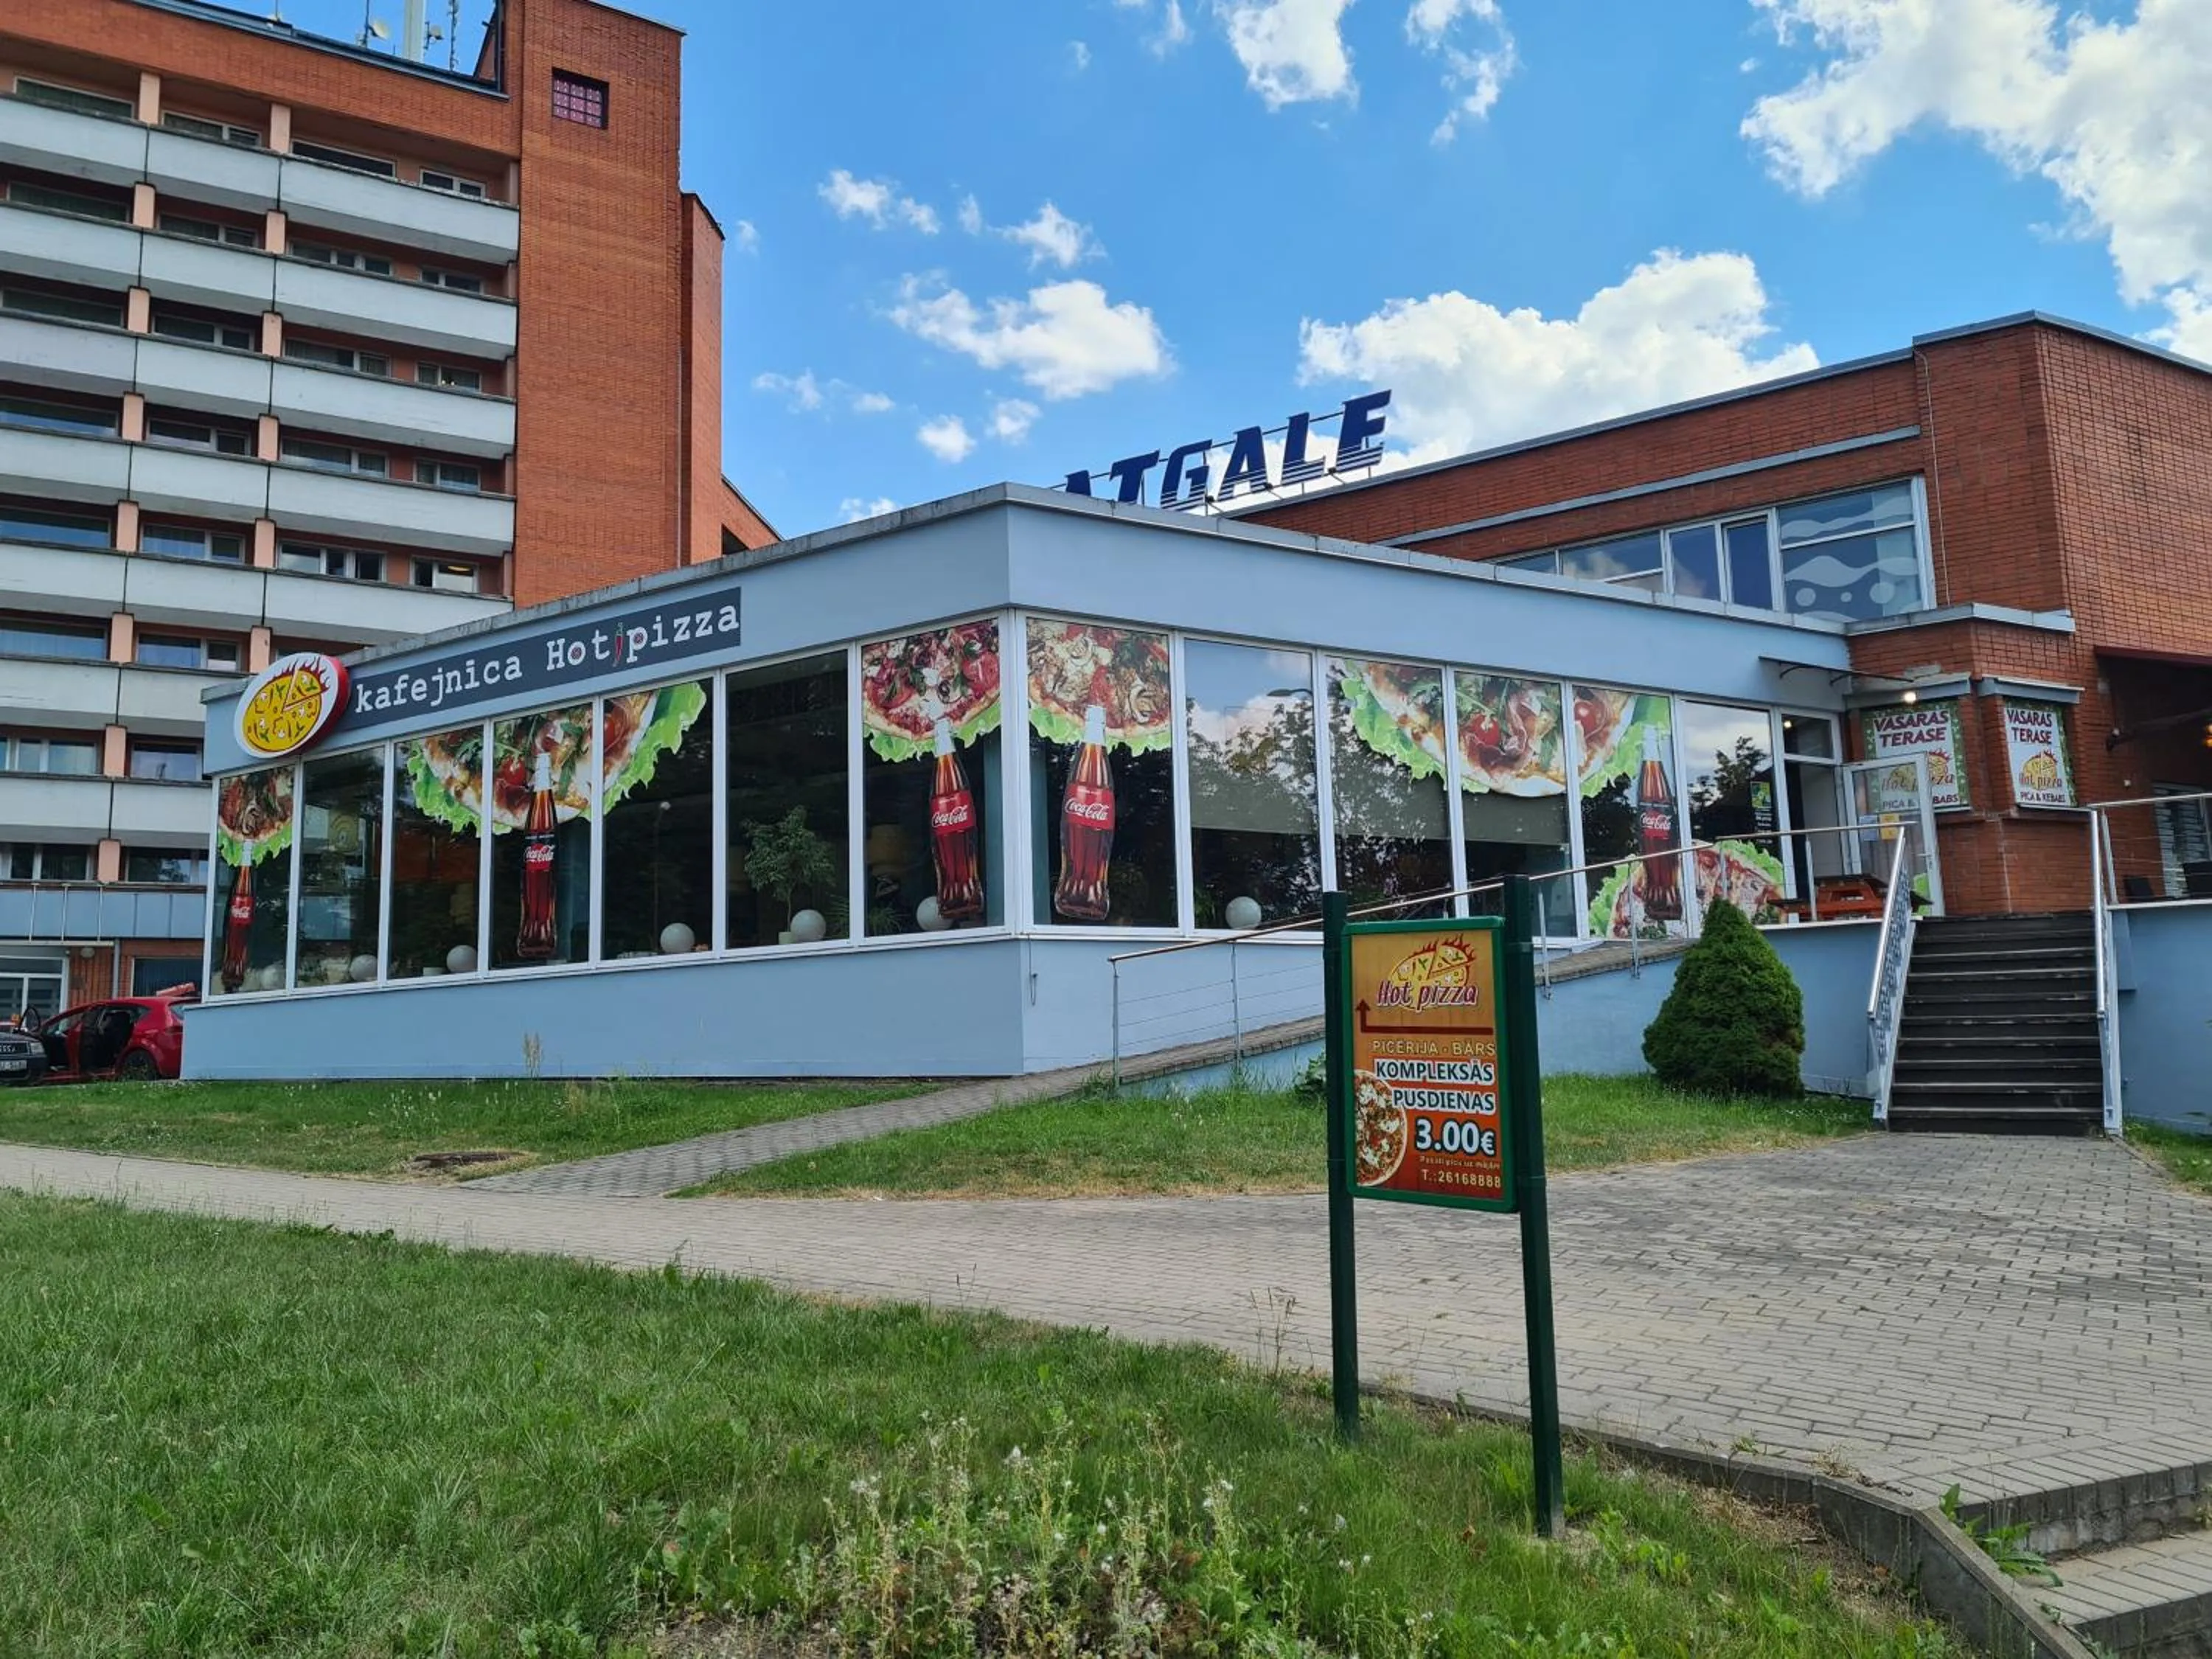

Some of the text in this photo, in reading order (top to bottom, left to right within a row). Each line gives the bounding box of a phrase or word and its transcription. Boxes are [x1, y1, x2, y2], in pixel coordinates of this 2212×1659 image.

[355, 605, 740, 713] kafejnica Hot pizza
[1874, 710, 1949, 732] VASARAS
[2006, 709, 2053, 728] VASARAS
[1880, 727, 1947, 748] TERASE
[2011, 726, 2052, 744] TERASE
[1377, 979, 1478, 1013] Hot pizza
[1392, 1090, 1496, 1112] PUSDIENAS
[1415, 1116, 1496, 1157] 3.00€
